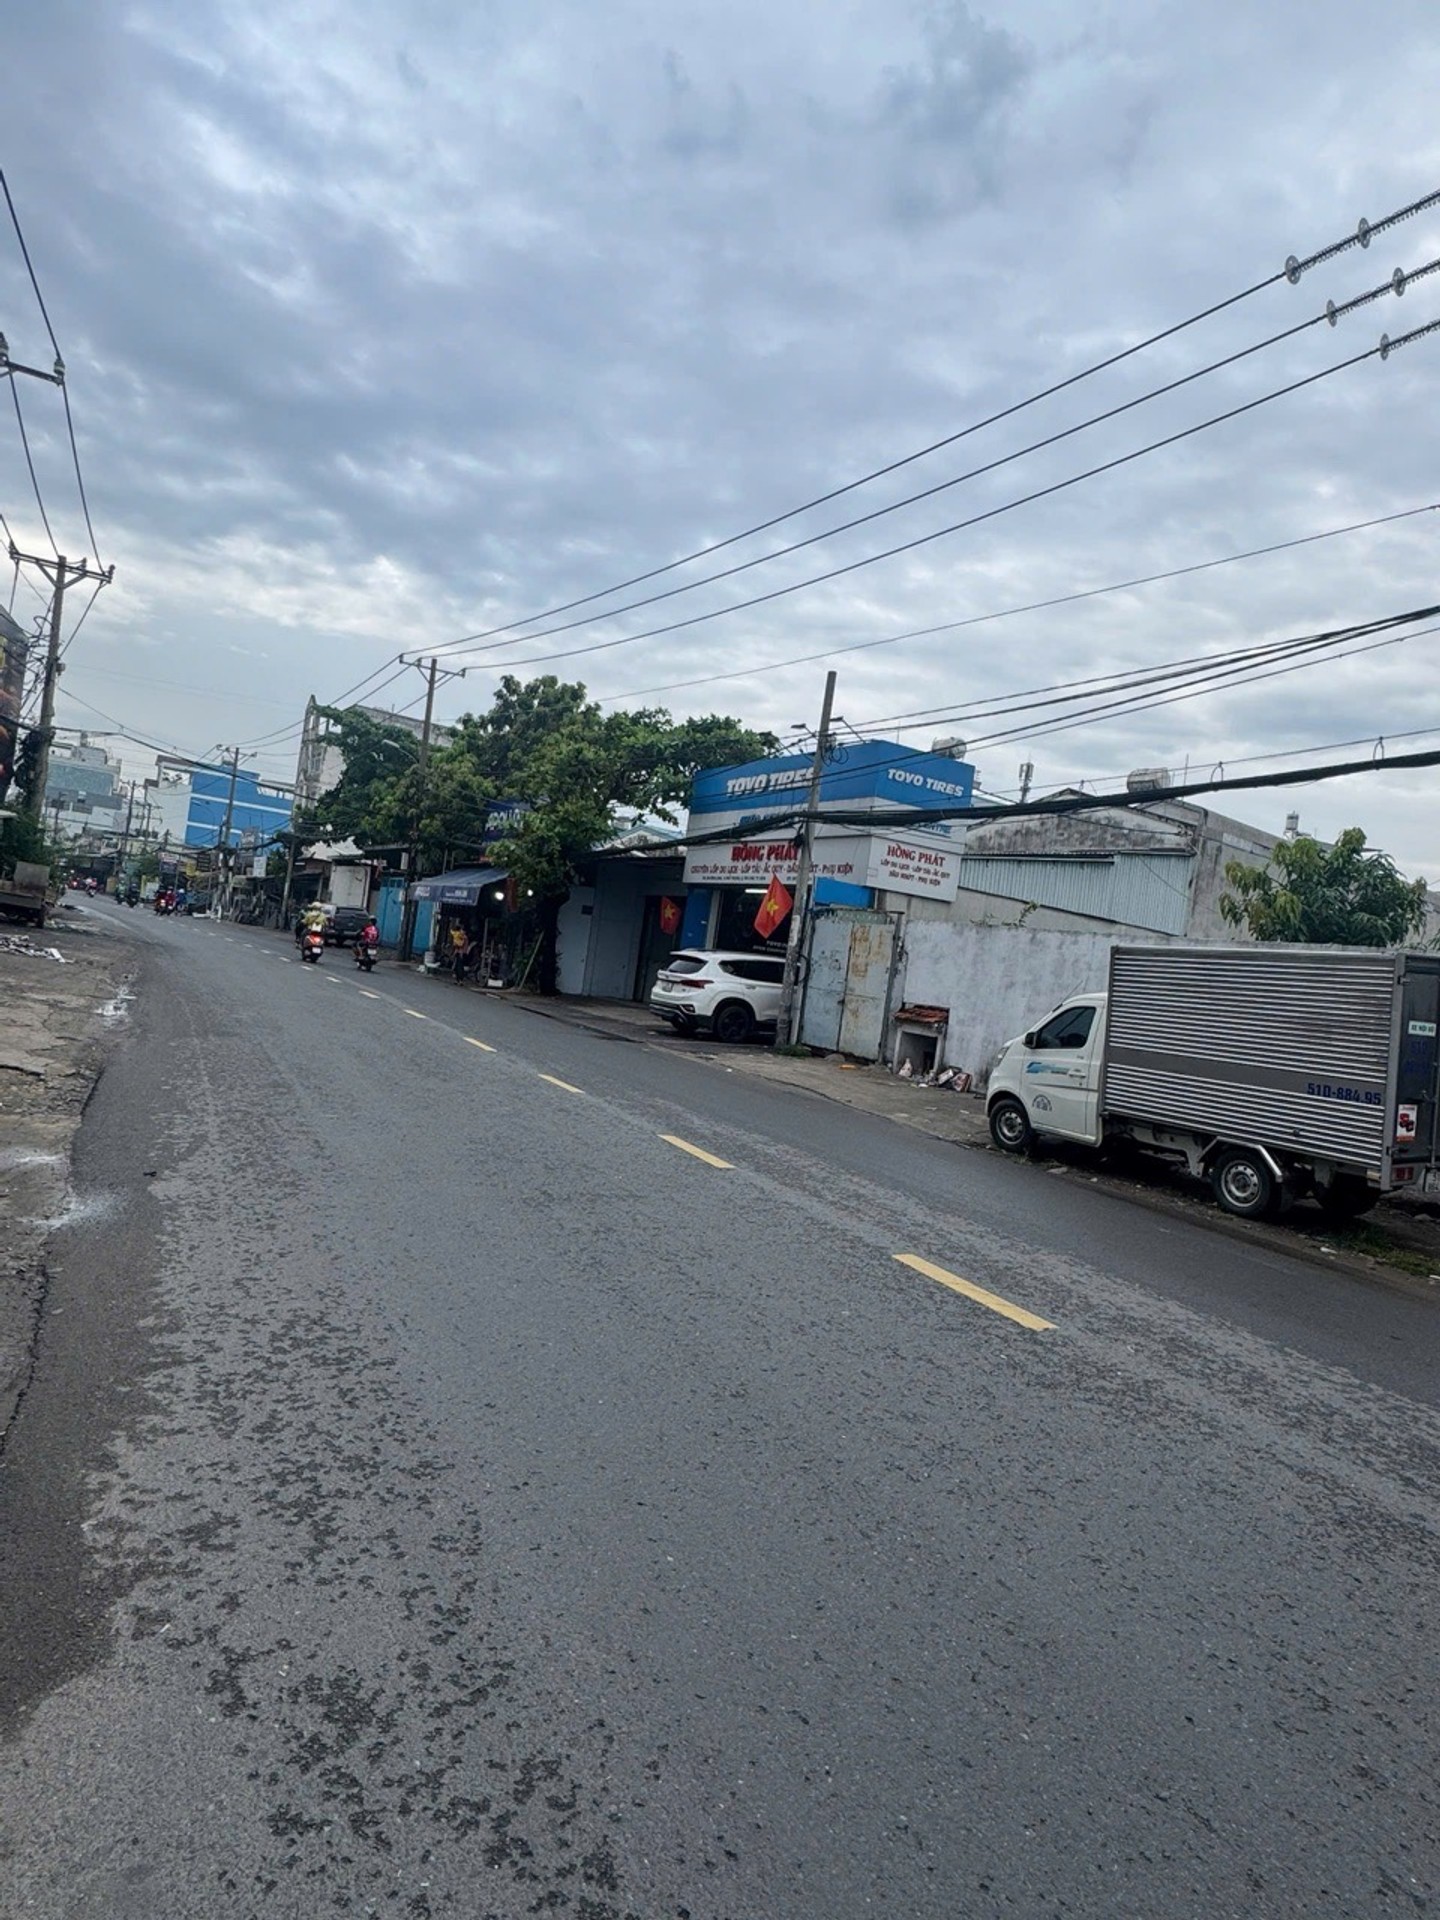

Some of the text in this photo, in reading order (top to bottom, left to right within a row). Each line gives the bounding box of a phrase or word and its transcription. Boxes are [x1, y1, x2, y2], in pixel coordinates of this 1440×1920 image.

[726, 774, 768, 797] TOYO
[887, 768, 964, 797] TOYO TIRES
[731, 842, 765, 862] HỒNG
[887, 843, 945, 867] HỒNG PHÁT
